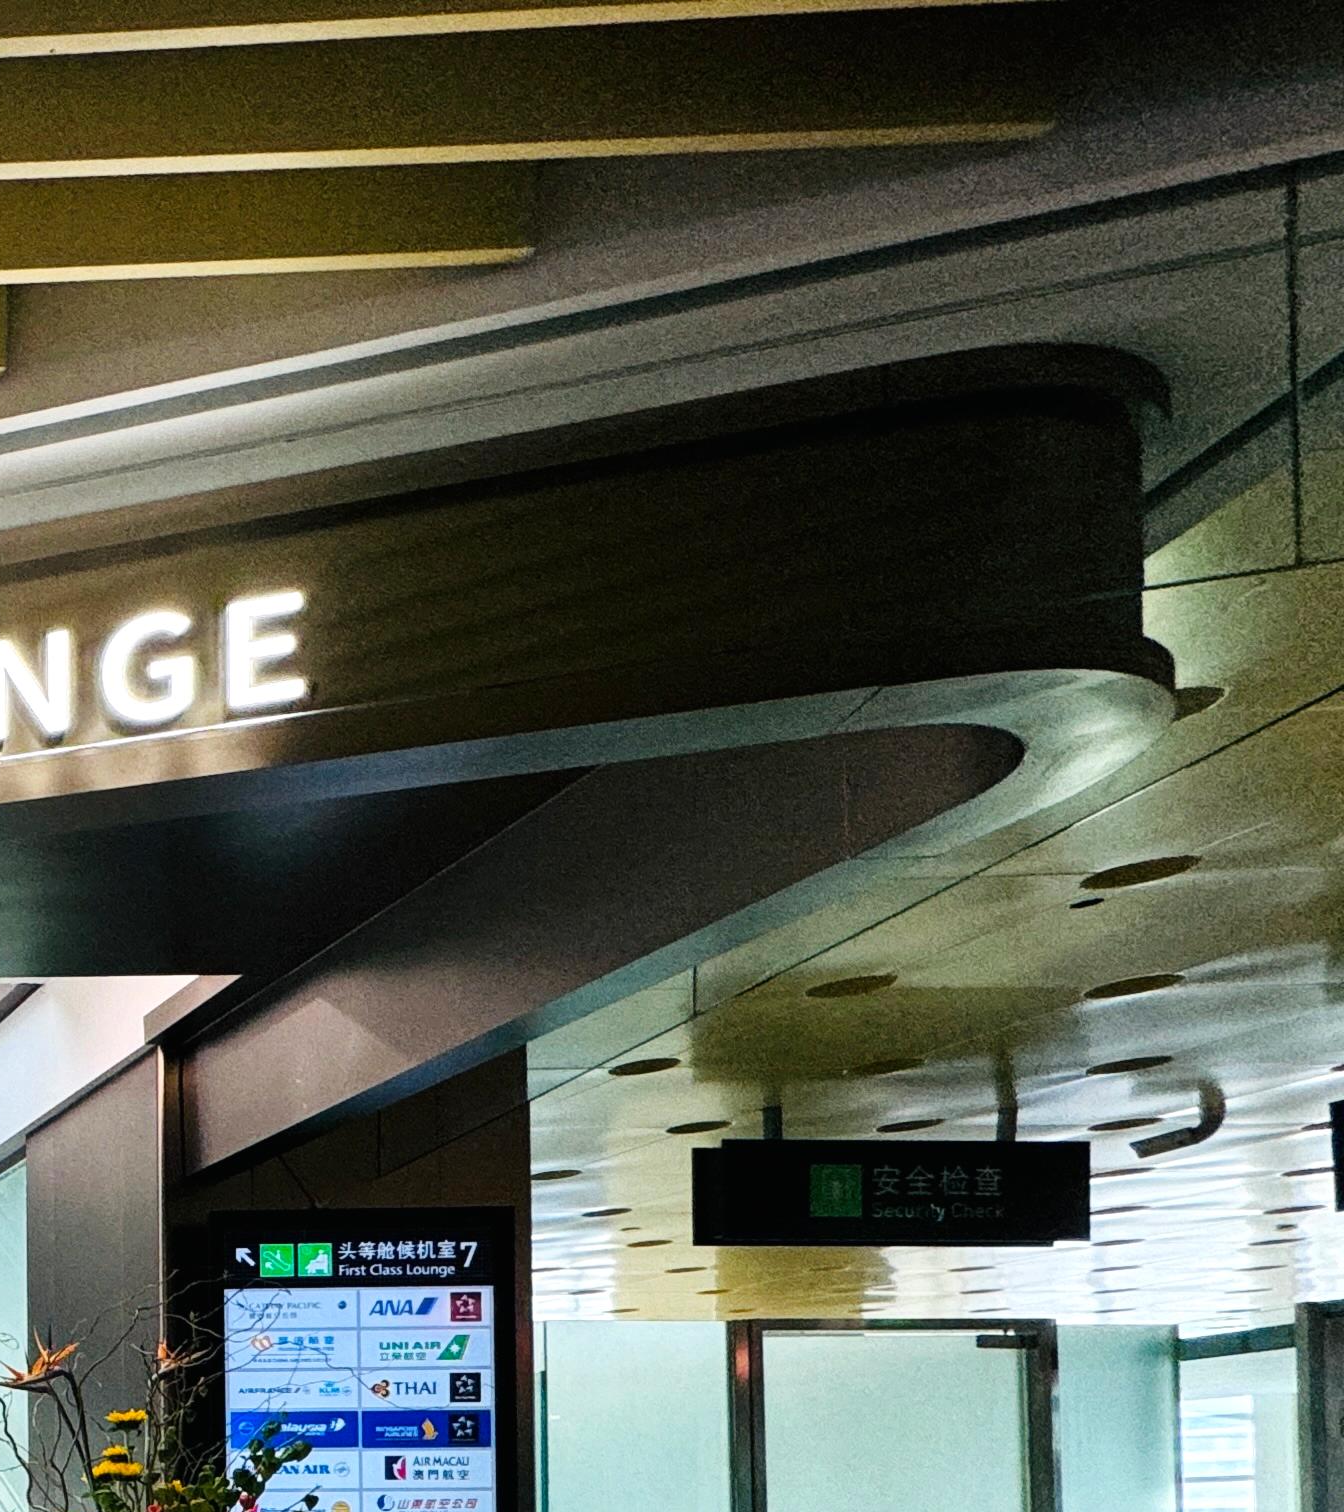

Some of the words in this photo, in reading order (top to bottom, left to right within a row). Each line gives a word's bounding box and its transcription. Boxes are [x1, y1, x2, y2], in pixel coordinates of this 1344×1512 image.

[872, 1165, 1002, 1196] 安全检查
[872, 1203, 945, 1221] Security
[951, 1203, 1004, 1218] Check
[338, 1240, 456, 1260] 头等舱候机室
[460, 1242, 478, 1267] 7
[339, 1264, 366, 1275] First
[370, 1263, 403, 1276] Class
[407, 1264, 455, 1277] Lounge
[369, 1300, 412, 1316] ANA
[379, 1341, 409, 1350] UNI
[412, 1341, 441, 1350] AIR
[393, 1382, 437, 1395] THAI
[413, 1456, 430, 1466] AIR
[433, 1456, 469, 1466] MACAU
[302, 1465, 330, 1474] AIR
